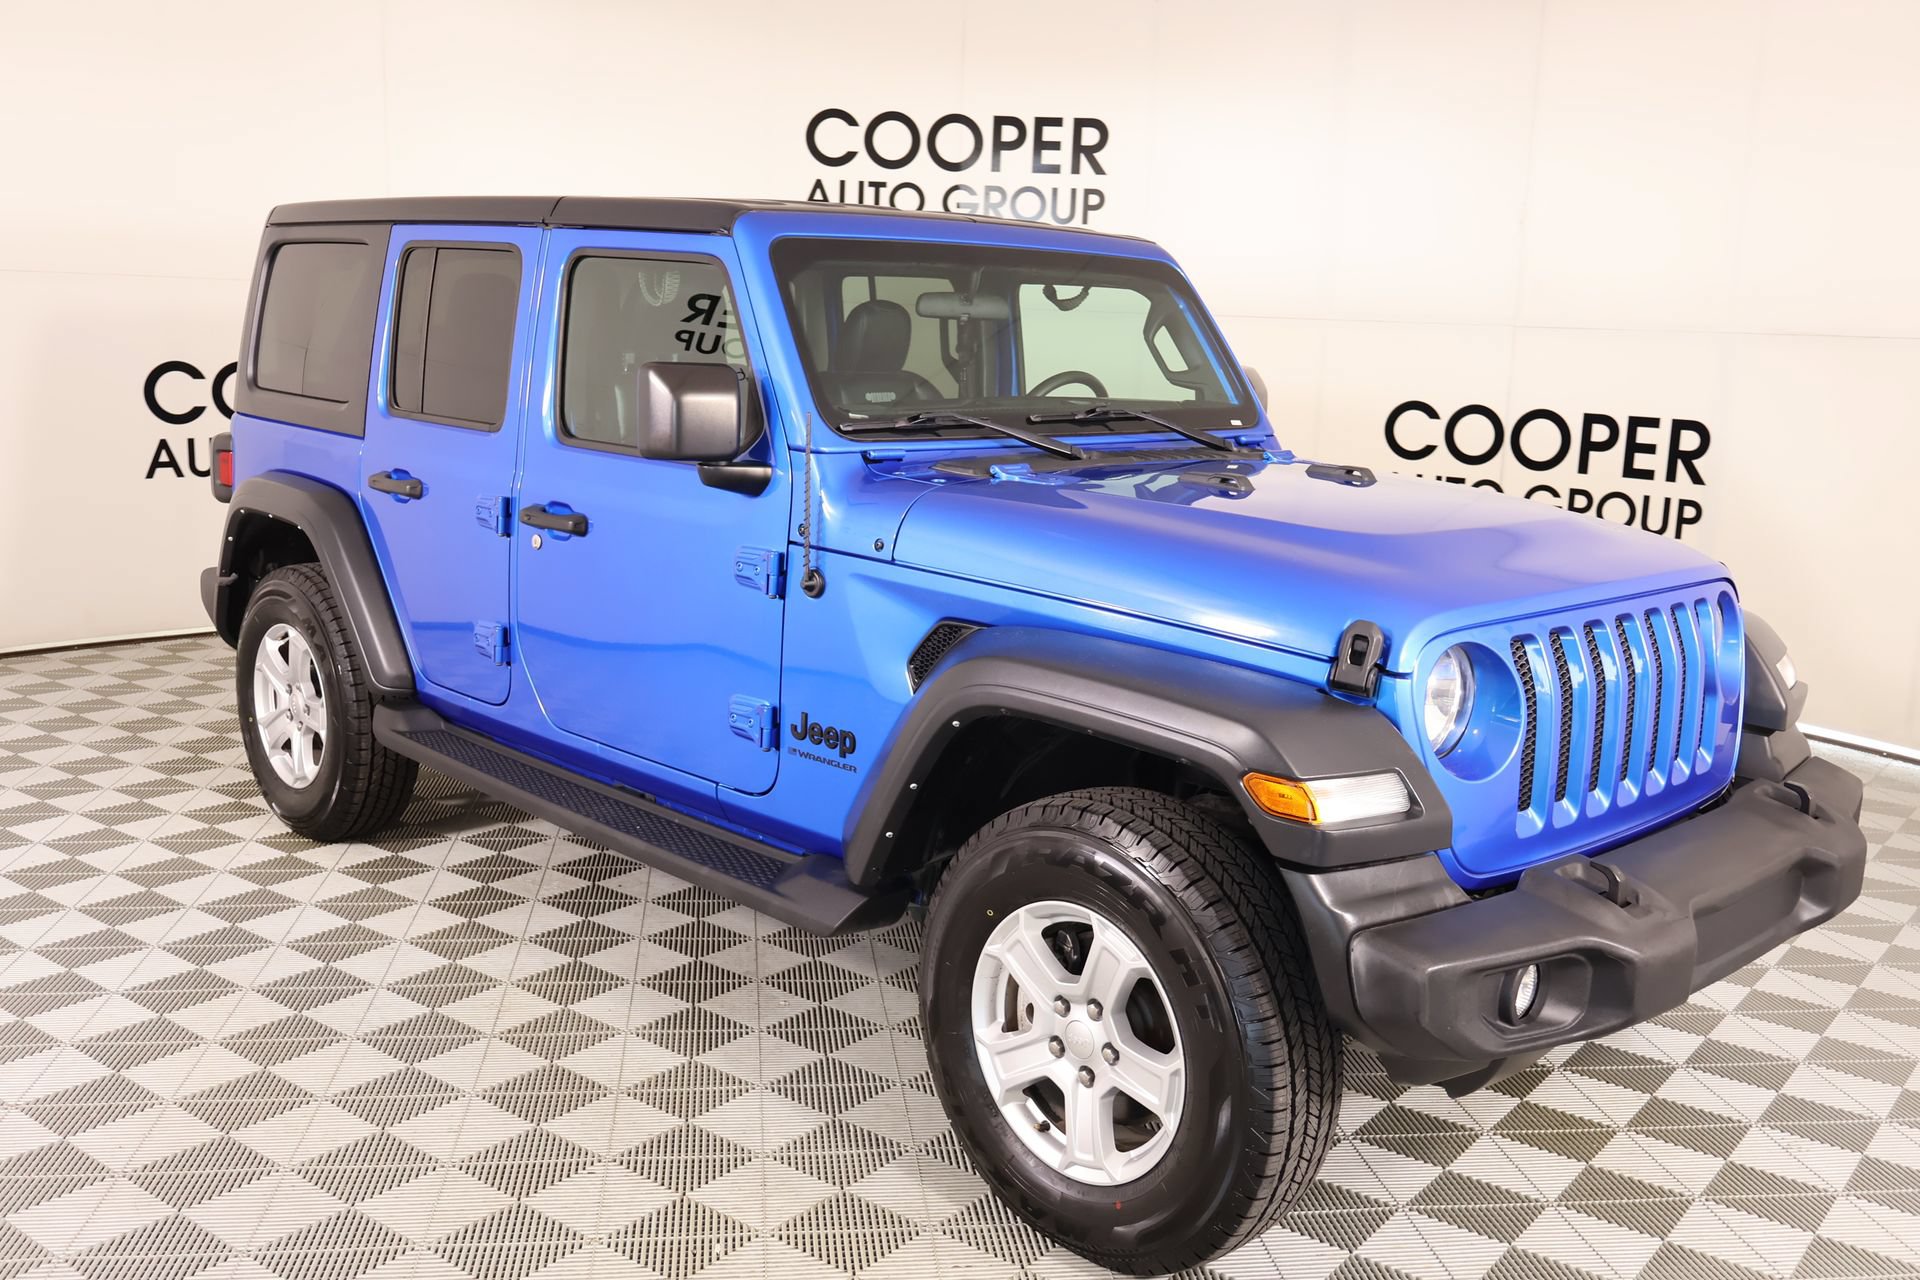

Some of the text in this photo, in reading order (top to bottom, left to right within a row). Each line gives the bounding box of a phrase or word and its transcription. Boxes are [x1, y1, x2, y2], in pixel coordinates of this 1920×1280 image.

[805, 107, 1109, 175] COOPER
[807, 178, 1105, 225] AUTO GROUP
[1384, 400, 1712, 486] COOPER
[790, 711, 857, 759] Jeep
[797, 748, 858, 774] WRANGLER
